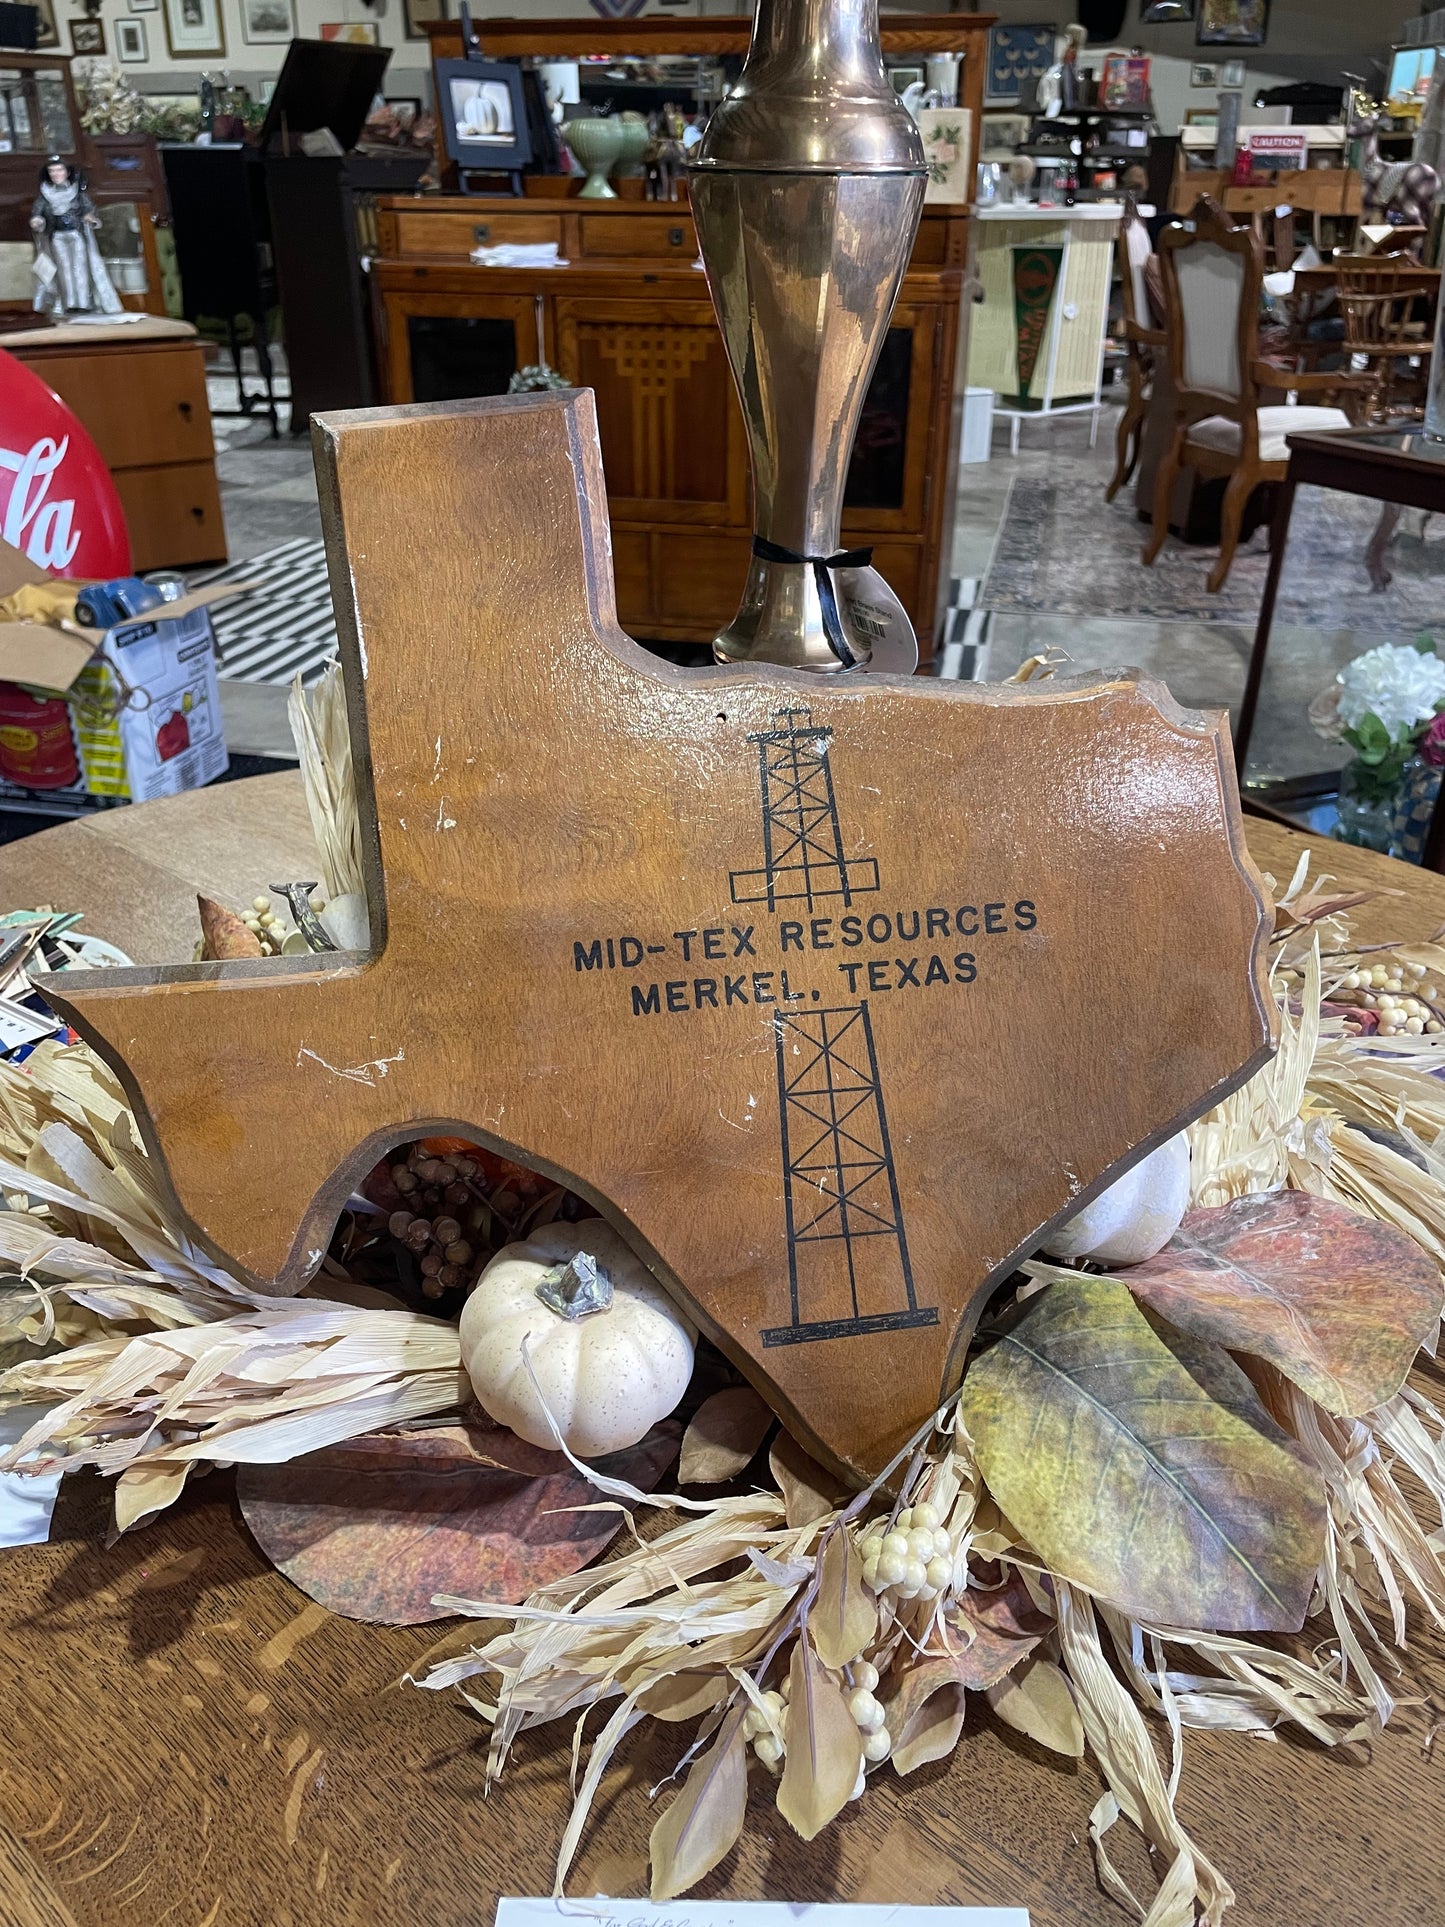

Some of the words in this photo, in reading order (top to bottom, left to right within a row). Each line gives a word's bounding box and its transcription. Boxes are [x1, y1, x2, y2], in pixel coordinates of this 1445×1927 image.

[1252, 136, 1301, 147] CAUTION
[574, 926, 756, 971] MID-TEX
[781, 901, 1036, 953] RESOURCES
[631, 971, 819, 1016] MERKEL,
[839, 953, 976, 998] TEXAS
